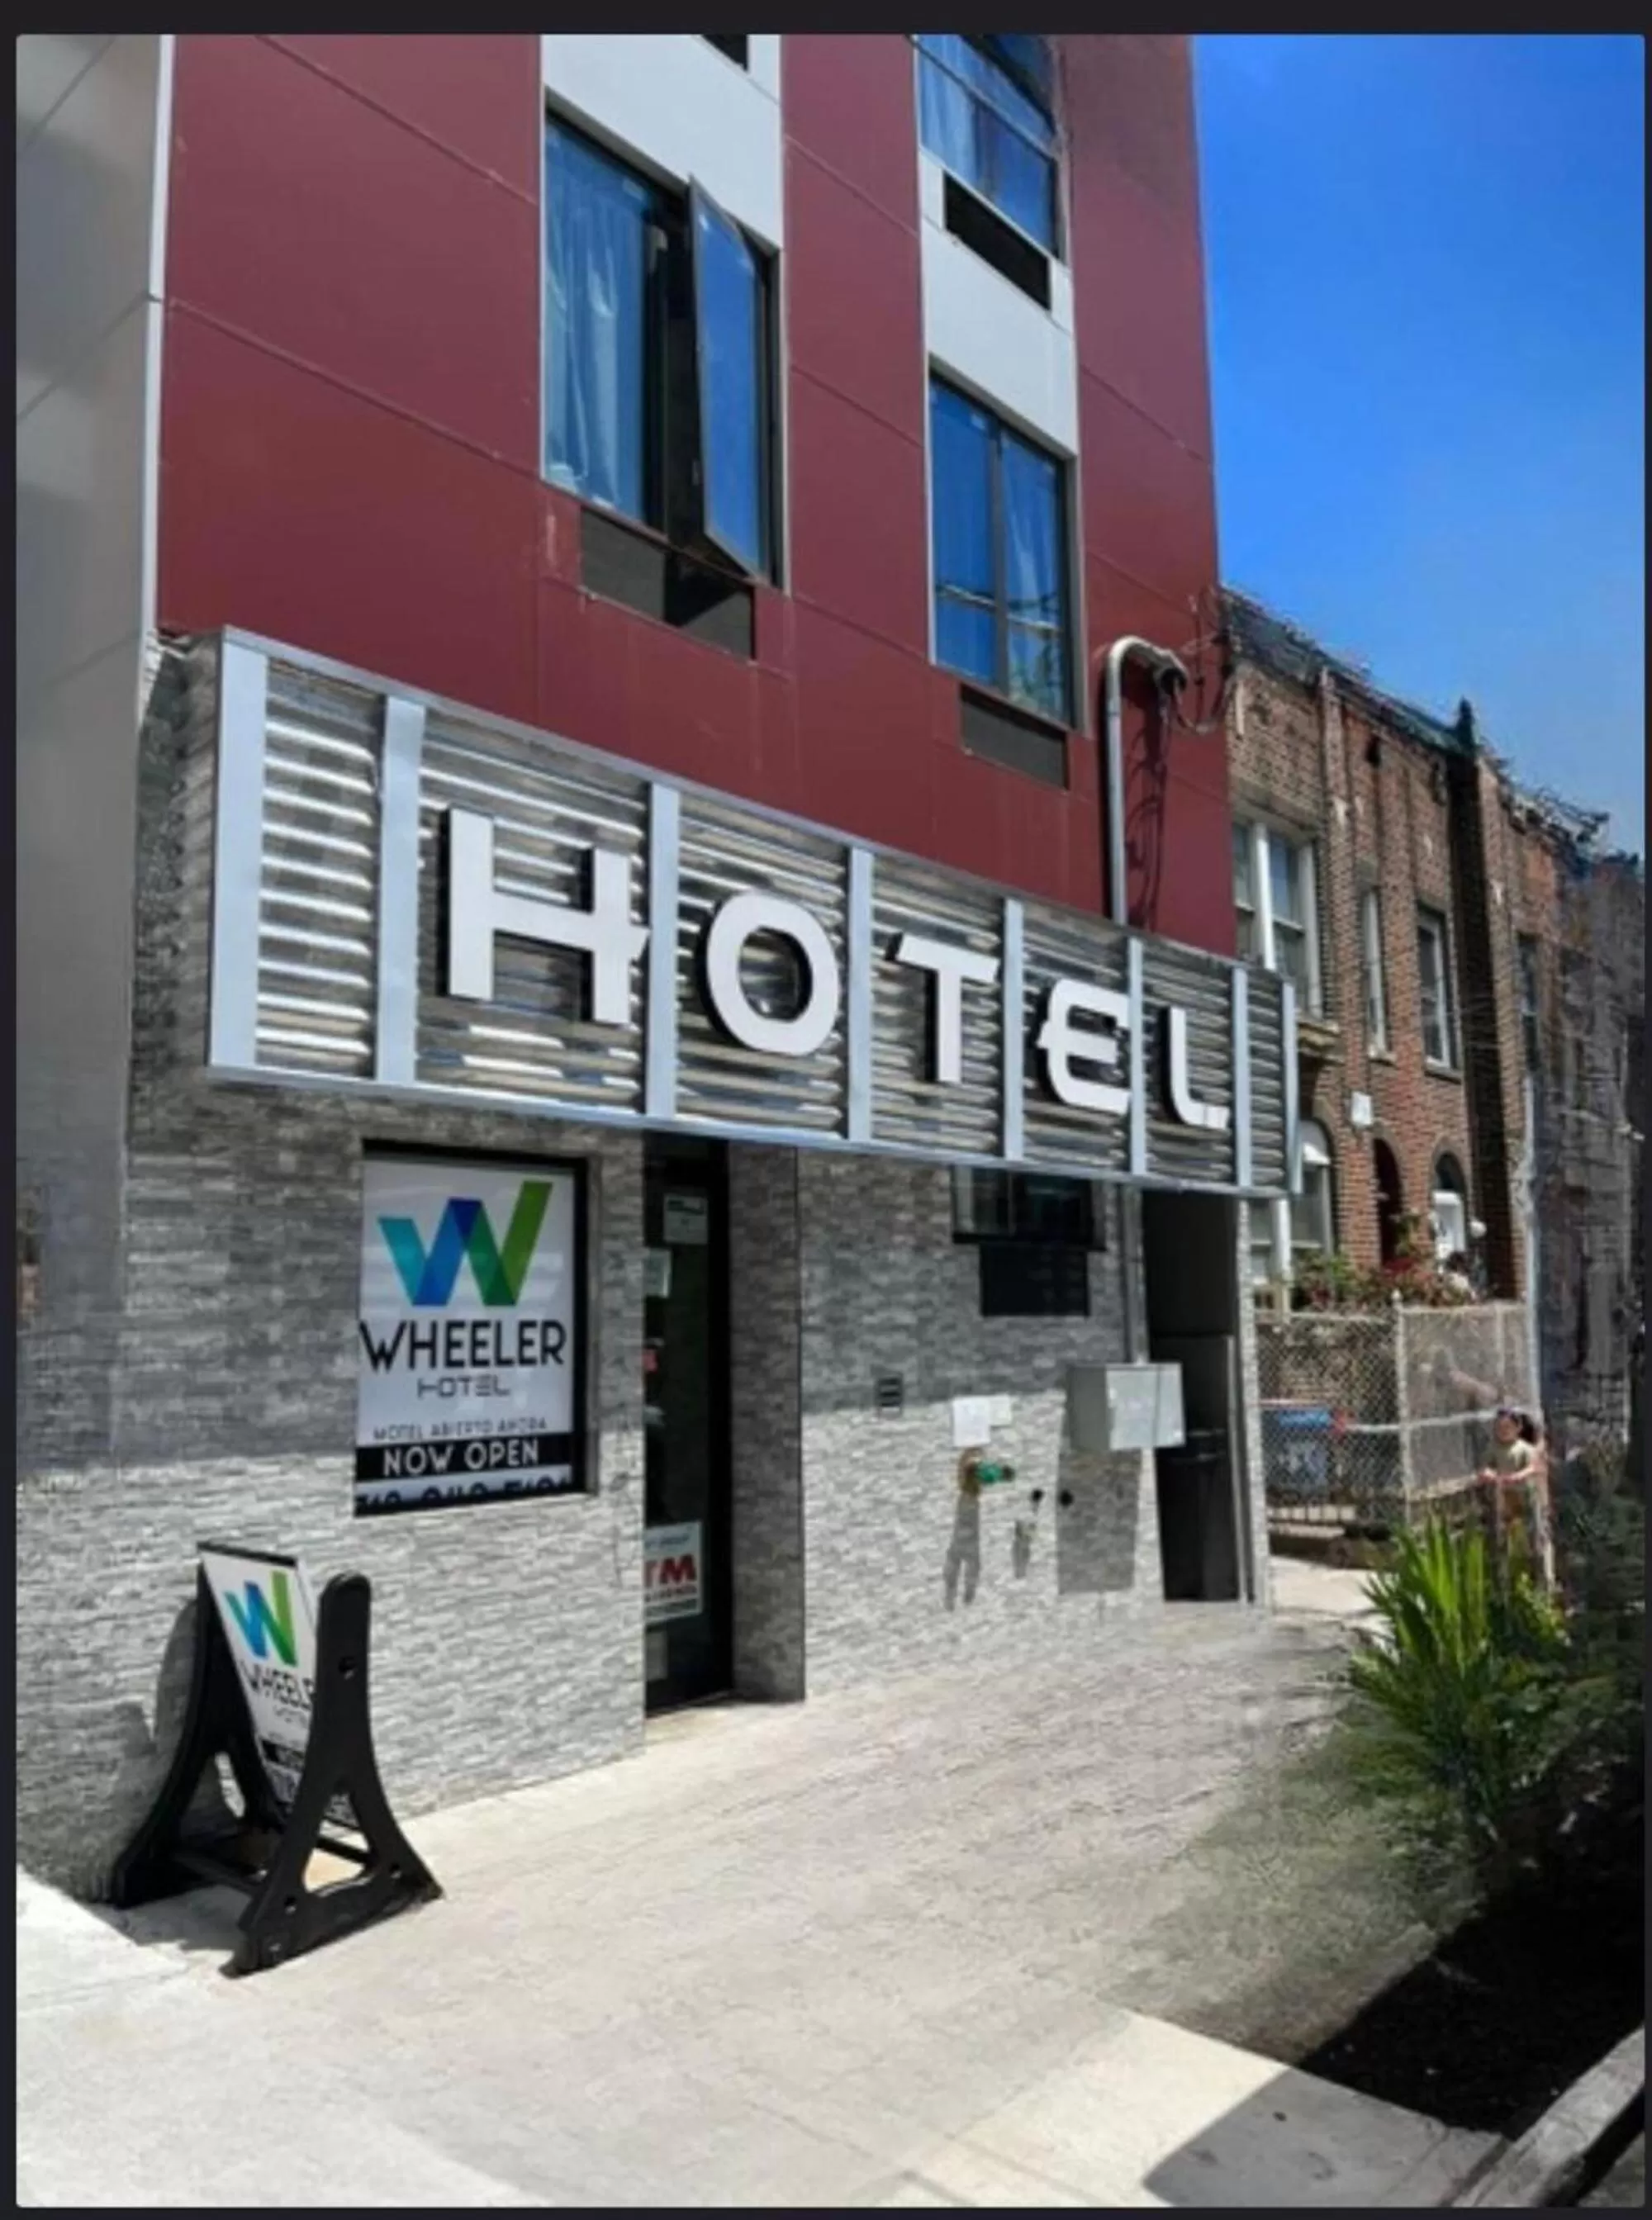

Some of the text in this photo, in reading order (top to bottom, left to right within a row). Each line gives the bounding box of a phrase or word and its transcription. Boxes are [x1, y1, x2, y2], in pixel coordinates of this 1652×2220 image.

[447, 807, 1229, 1130] HOTEL
[358, 1319, 567, 1373] WHEELER
[417, 1374, 510, 1399] HOTEL
[383, 1438, 539, 1478] NOW OPEN
[644, 1554, 697, 1587] TM
